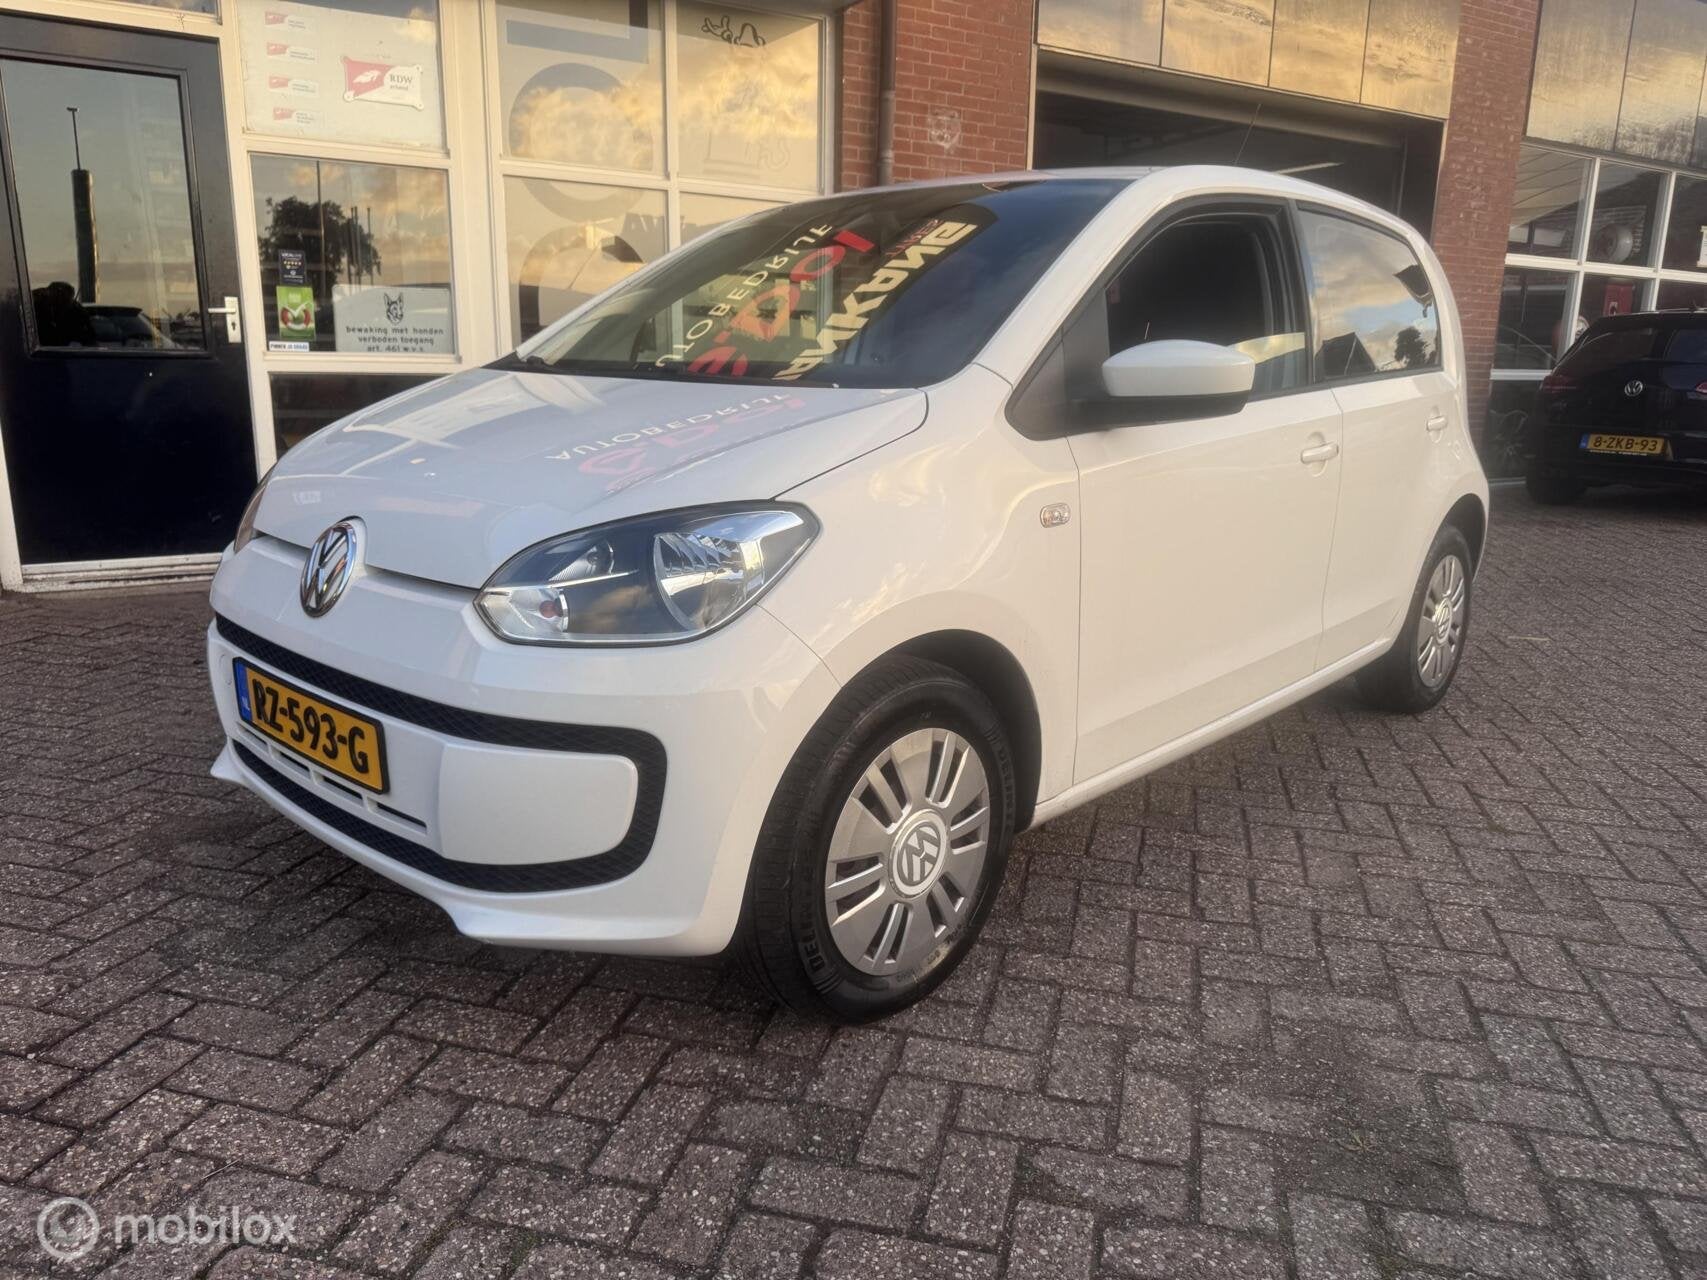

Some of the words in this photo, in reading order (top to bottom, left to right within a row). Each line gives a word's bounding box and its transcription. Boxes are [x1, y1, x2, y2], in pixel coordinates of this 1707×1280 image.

[389, 73, 413, 85] RDW
[346, 326, 388, 336] bewaking
[413, 327, 444, 335] honden
[400, 336, 434, 346] toegang
[1593, 437, 1658, 451] 8-ZKB-93
[252, 678, 369, 774] RZ-593-G
